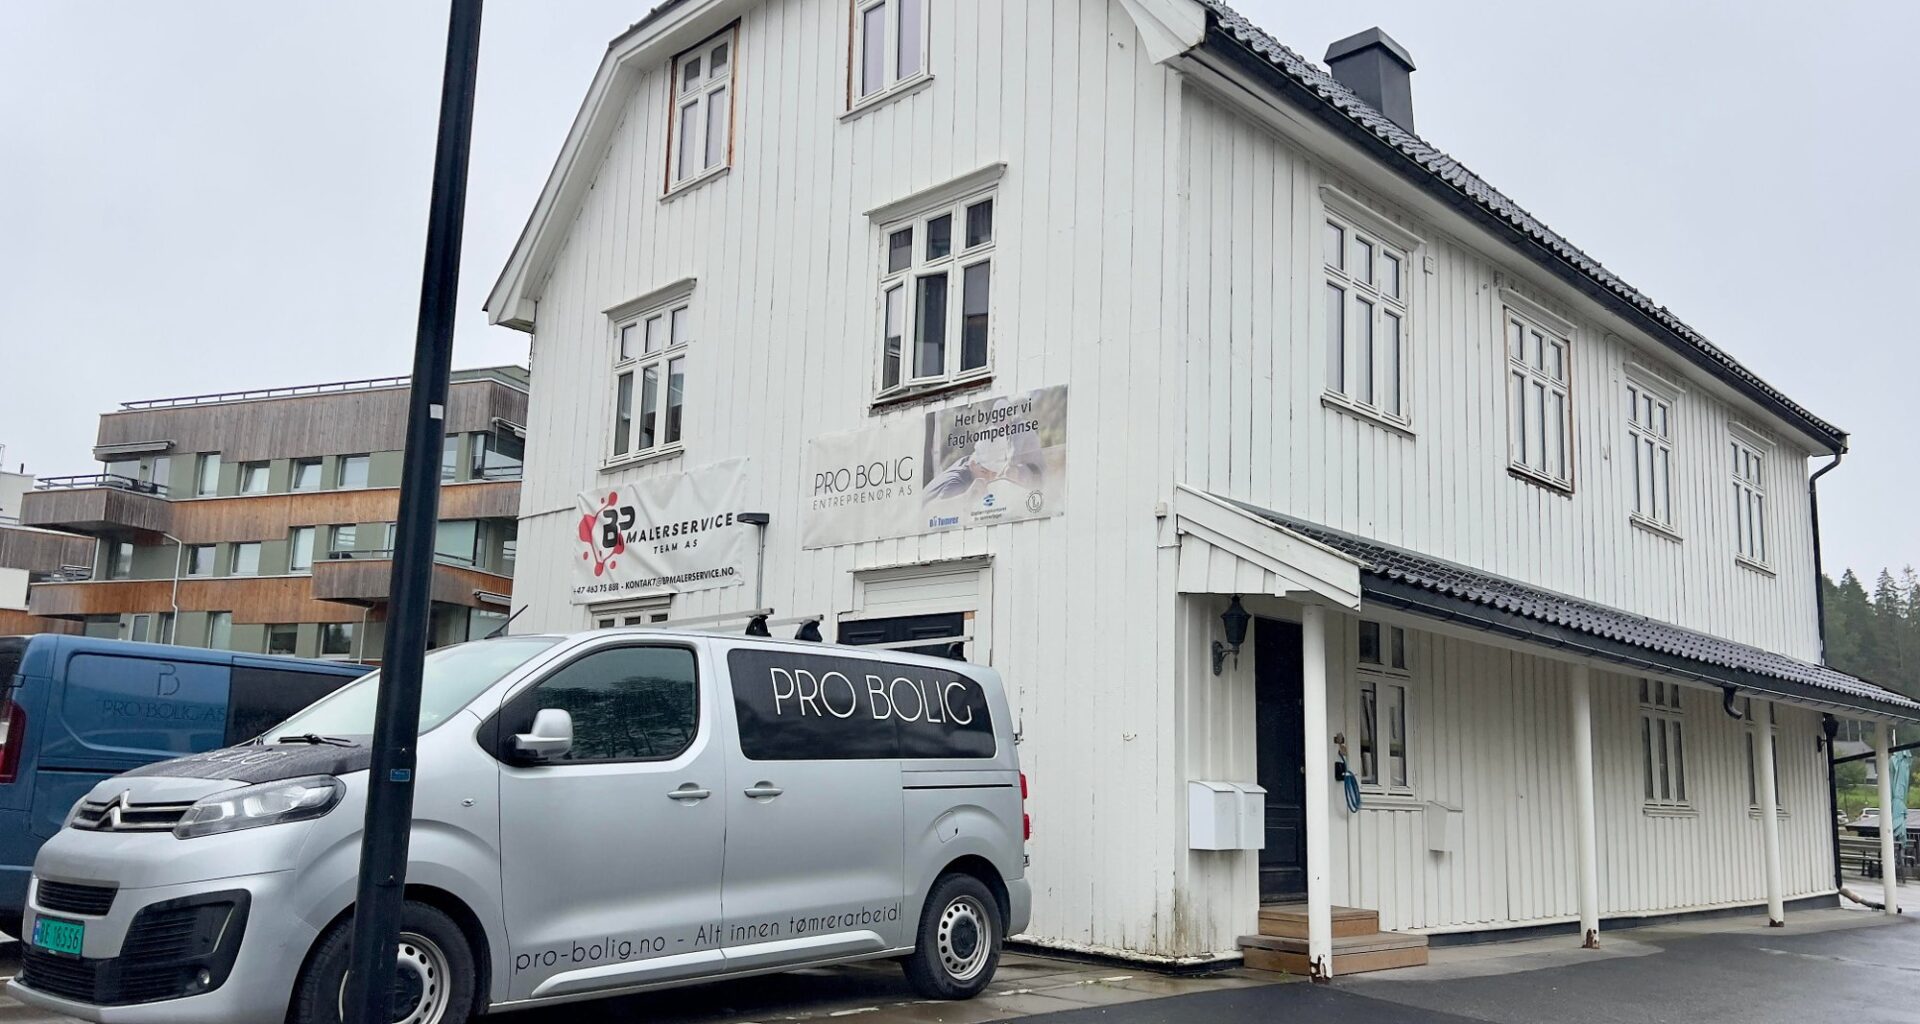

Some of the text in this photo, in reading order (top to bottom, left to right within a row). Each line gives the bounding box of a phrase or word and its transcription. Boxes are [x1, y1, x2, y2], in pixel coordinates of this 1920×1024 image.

[955, 398, 1032, 428] Her bygger vi
[948, 419, 1039, 449] fagkompetanse
[814, 456, 913, 496] PRO BOLIG
[813, 486, 913, 510] ENTREPRENØR AS
[602, 506, 636, 549] BP
[626, 512, 733, 544] MALERSERVICE
[653, 539, 698, 554] TEAM AS
[103, 701, 225, 721] PRO BOLIG AS
[770, 667, 973, 725] PRO BOLIG
[515, 936, 666, 975] pro-bolig.no
[695, 926, 721, 947] Alt
[730, 919, 780, 942] innen
[790, 902, 901, 934] tømrerarbeid!
